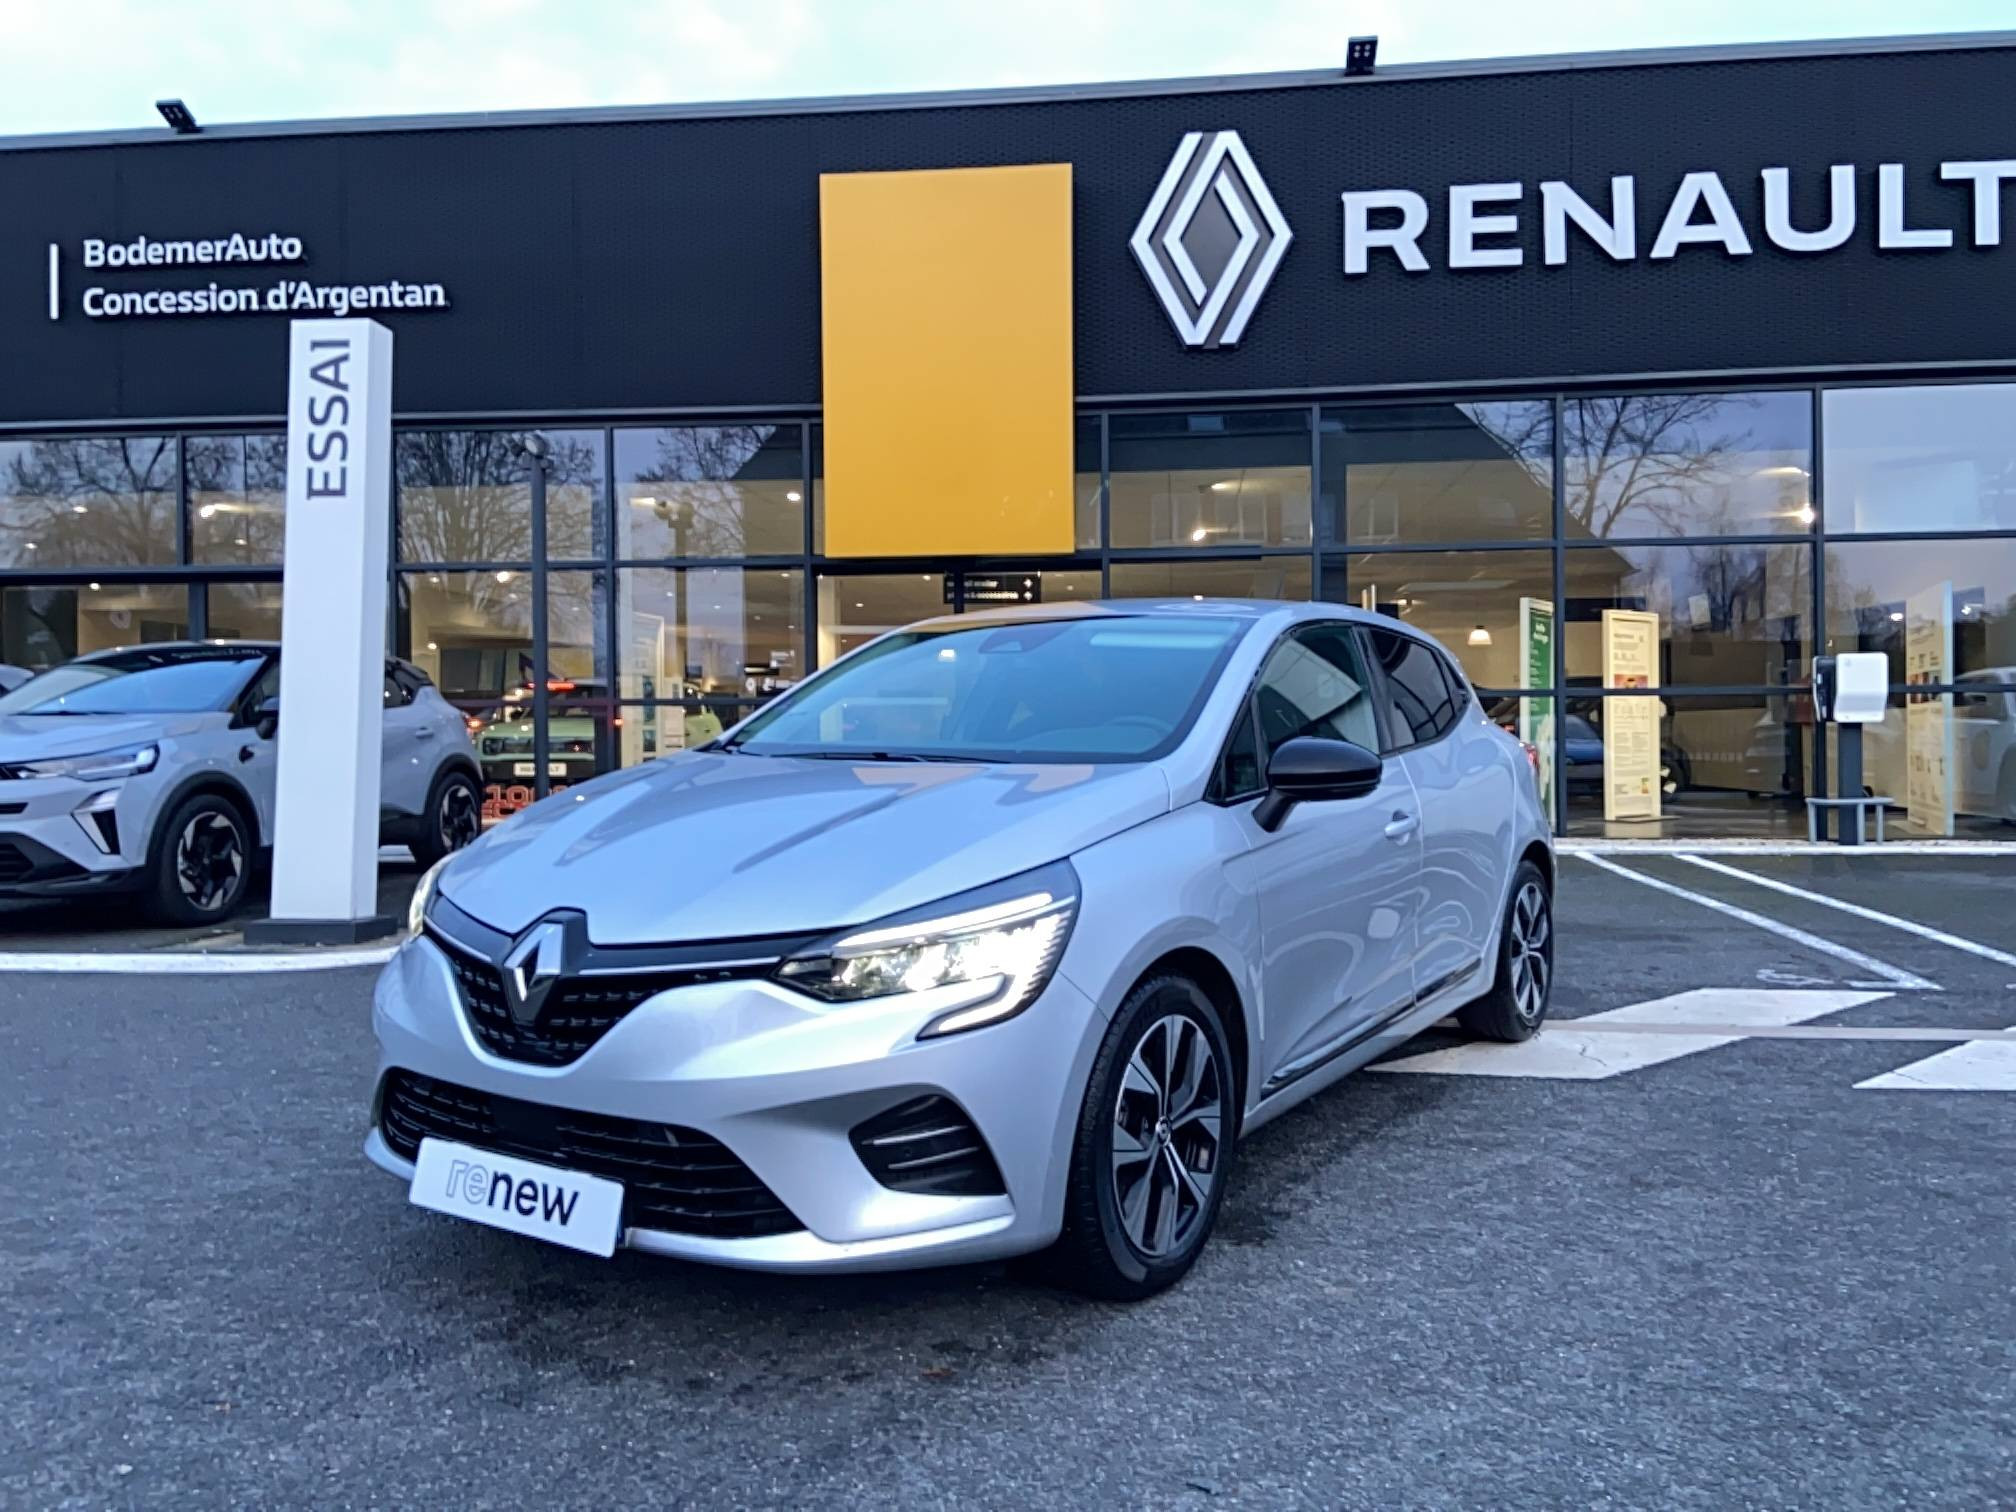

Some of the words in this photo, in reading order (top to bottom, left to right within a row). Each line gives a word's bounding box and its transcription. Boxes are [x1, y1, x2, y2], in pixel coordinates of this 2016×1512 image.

[83, 233, 302, 268] BodemerAuto
[1342, 160, 2016, 274] RENAULT
[83, 283, 259, 316] Concession
[266, 280, 446, 316] d'Argentan
[306, 340, 350, 500] ESSAI
[446, 1159, 579, 1226] renew
